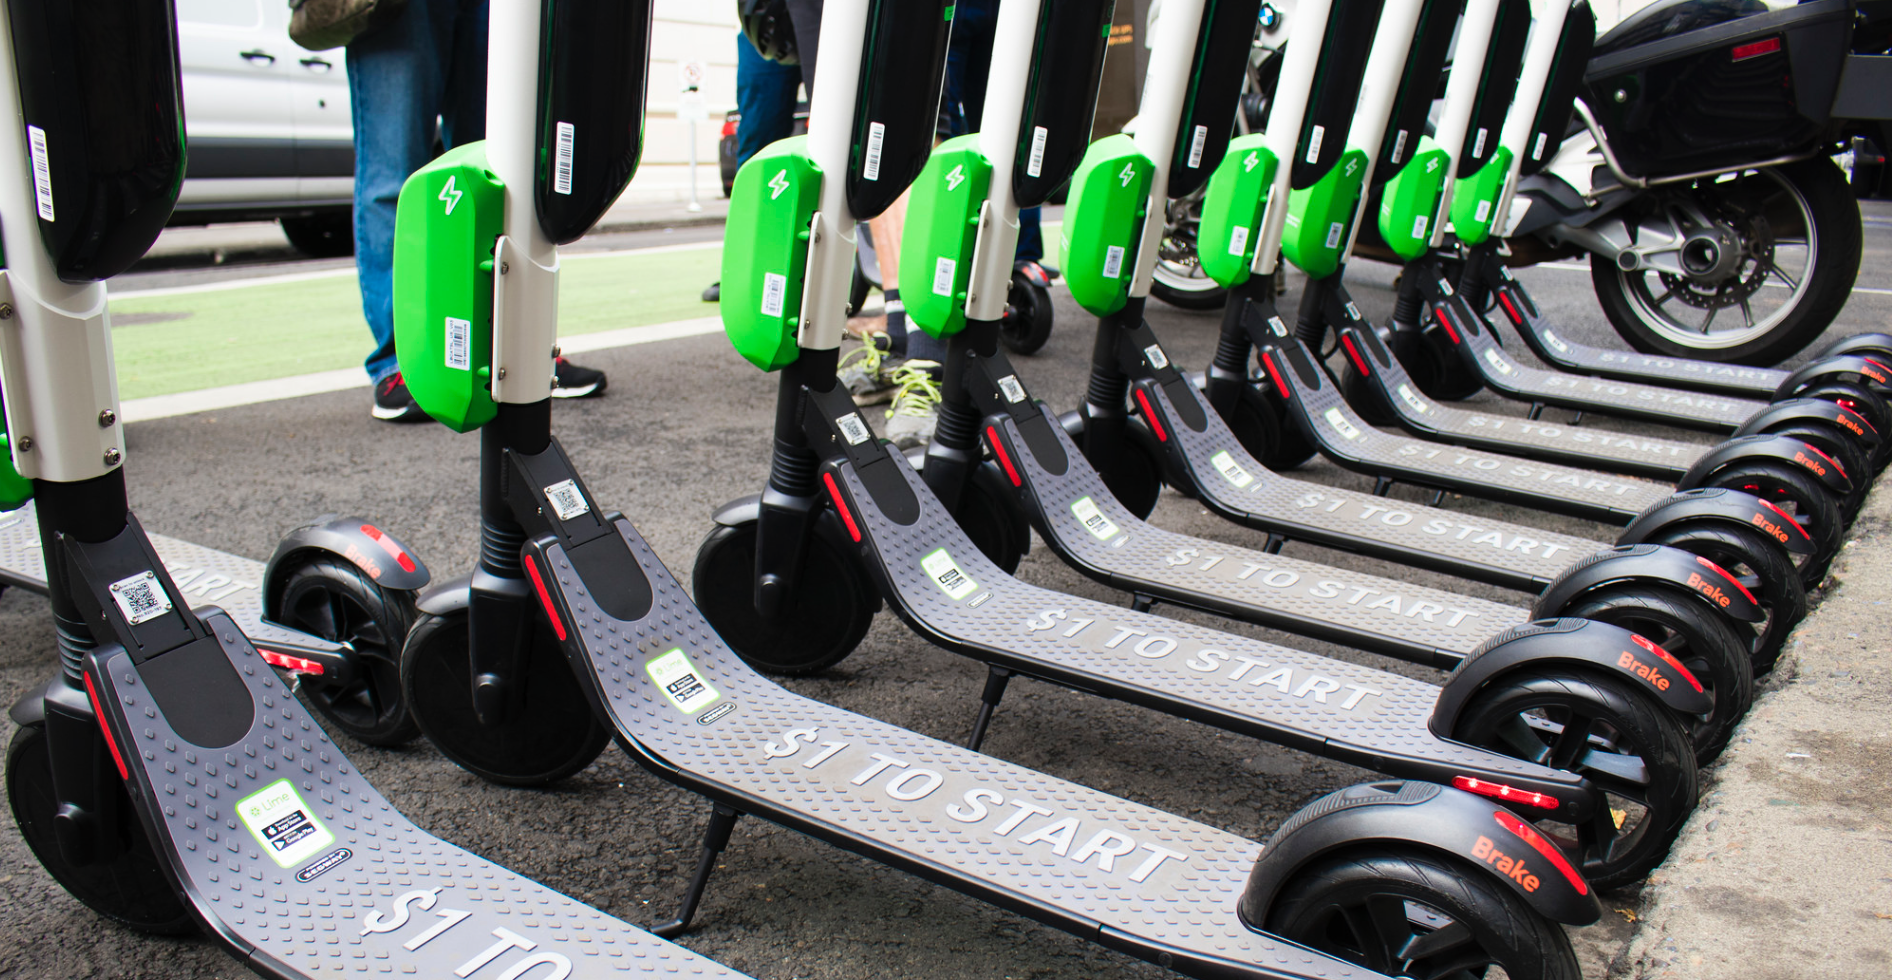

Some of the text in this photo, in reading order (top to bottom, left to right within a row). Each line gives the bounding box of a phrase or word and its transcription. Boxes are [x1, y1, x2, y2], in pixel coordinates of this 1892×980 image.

[1543, 376, 1739, 412] $1 TO START
[1861, 365, 1887, 384] Brake
[1467, 415, 1690, 457] $1 TO START
[1836, 413, 1864, 436] Brake
[1399, 444, 1638, 496] $1 TO START
[1794, 451, 1826, 477] Brake
[1296, 492, 1571, 560] $1 TO START
[1751, 512, 1789, 544] Brake
[344, 544, 381, 579] Brake
[1165, 548, 1480, 628] $1 TO START
[1686, 572, 1731, 608] Brake
[1026, 608, 1383, 710] $1 TO START
[1617, 651, 1670, 691] Brake
[262, 792, 290, 811] Lime
[763, 726, 1189, 883] $1 TO START
[1470, 835, 1540, 893] Brake
[358, 886, 573, 980] $1 TO
